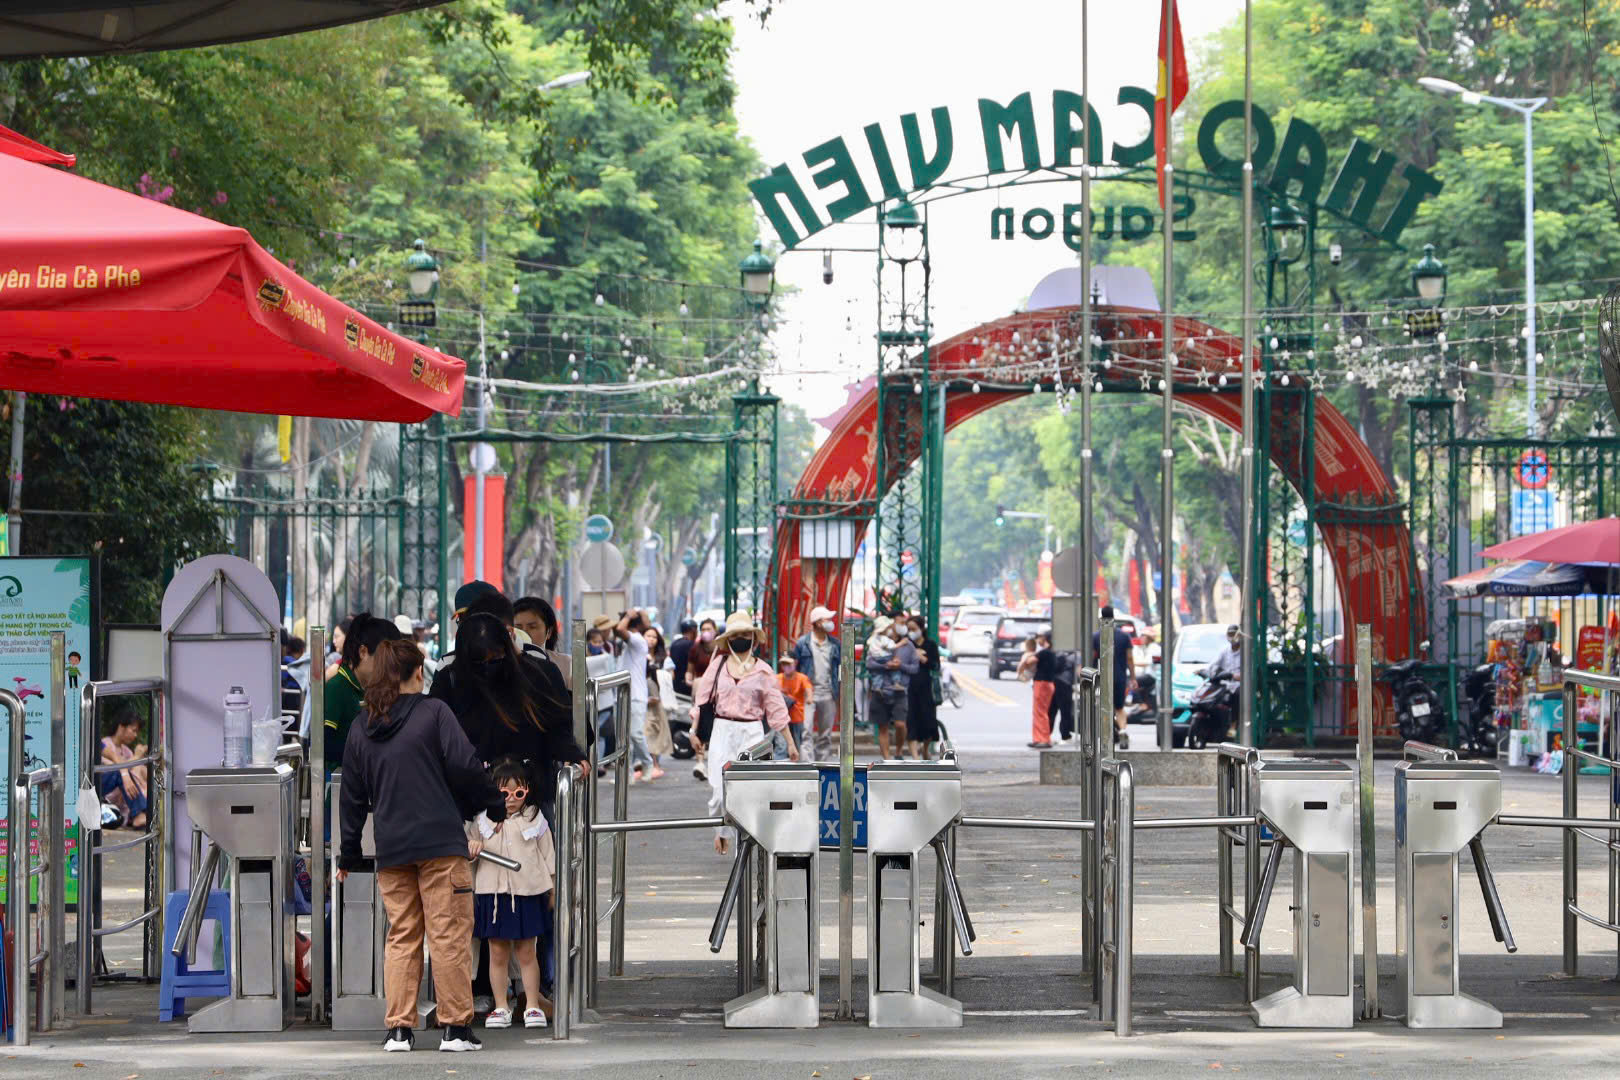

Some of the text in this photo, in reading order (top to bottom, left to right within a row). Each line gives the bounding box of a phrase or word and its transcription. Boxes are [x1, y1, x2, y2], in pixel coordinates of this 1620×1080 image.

[37, 265, 67, 288] Gia
[73, 265, 98, 288] Cà
[105, 265, 141, 288] Phê
